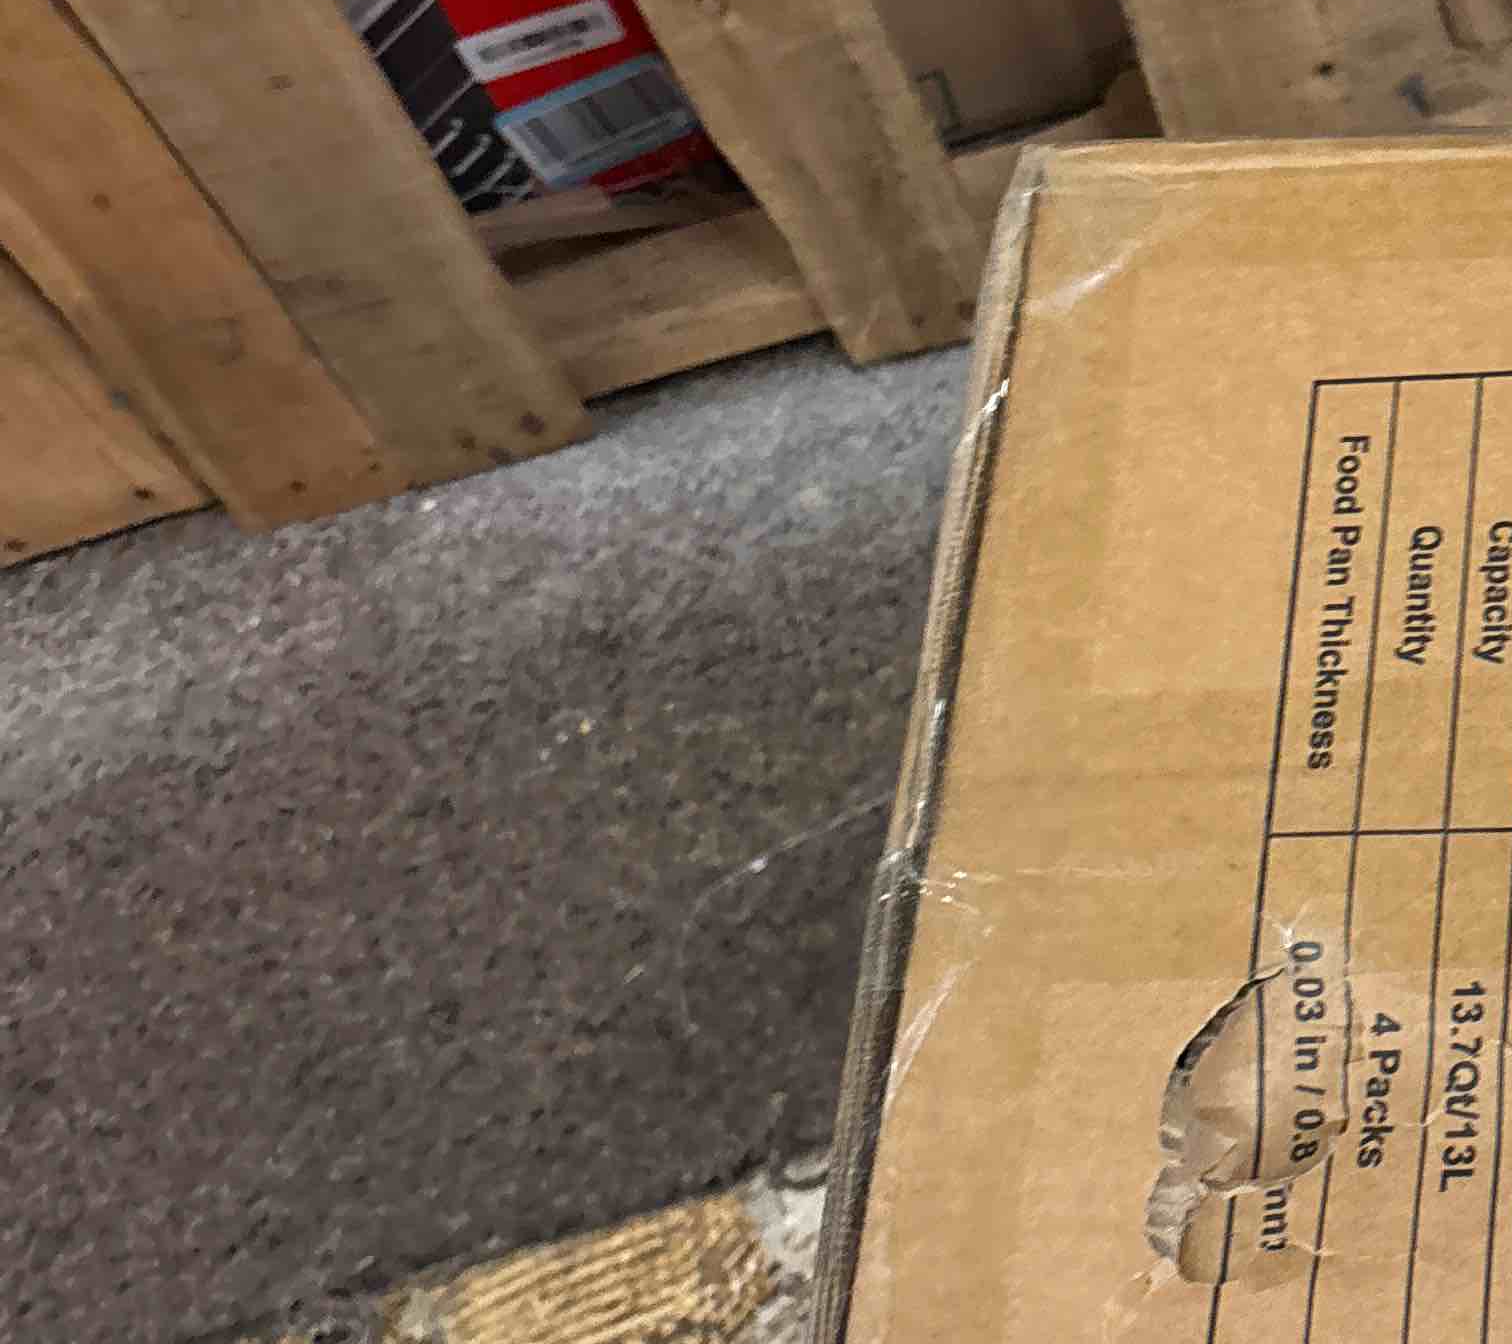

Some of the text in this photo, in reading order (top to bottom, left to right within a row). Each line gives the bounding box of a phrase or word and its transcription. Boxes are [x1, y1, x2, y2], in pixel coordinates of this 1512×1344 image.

[1308, 434, 1371, 769] Food Pan Thickness
[1394, 525, 1444, 666] Quantity
[1290, 941, 1326, 1021] 0.03
[1294, 1034, 1326, 1072] in
[1294, 1084, 1327, 1097] /
[1357, 1012, 1401, 1169] 4 Packs
[1437, 982, 1486, 1193] 13.7Qt/13L
[1289, 1109, 1326, 1162] 0.8
